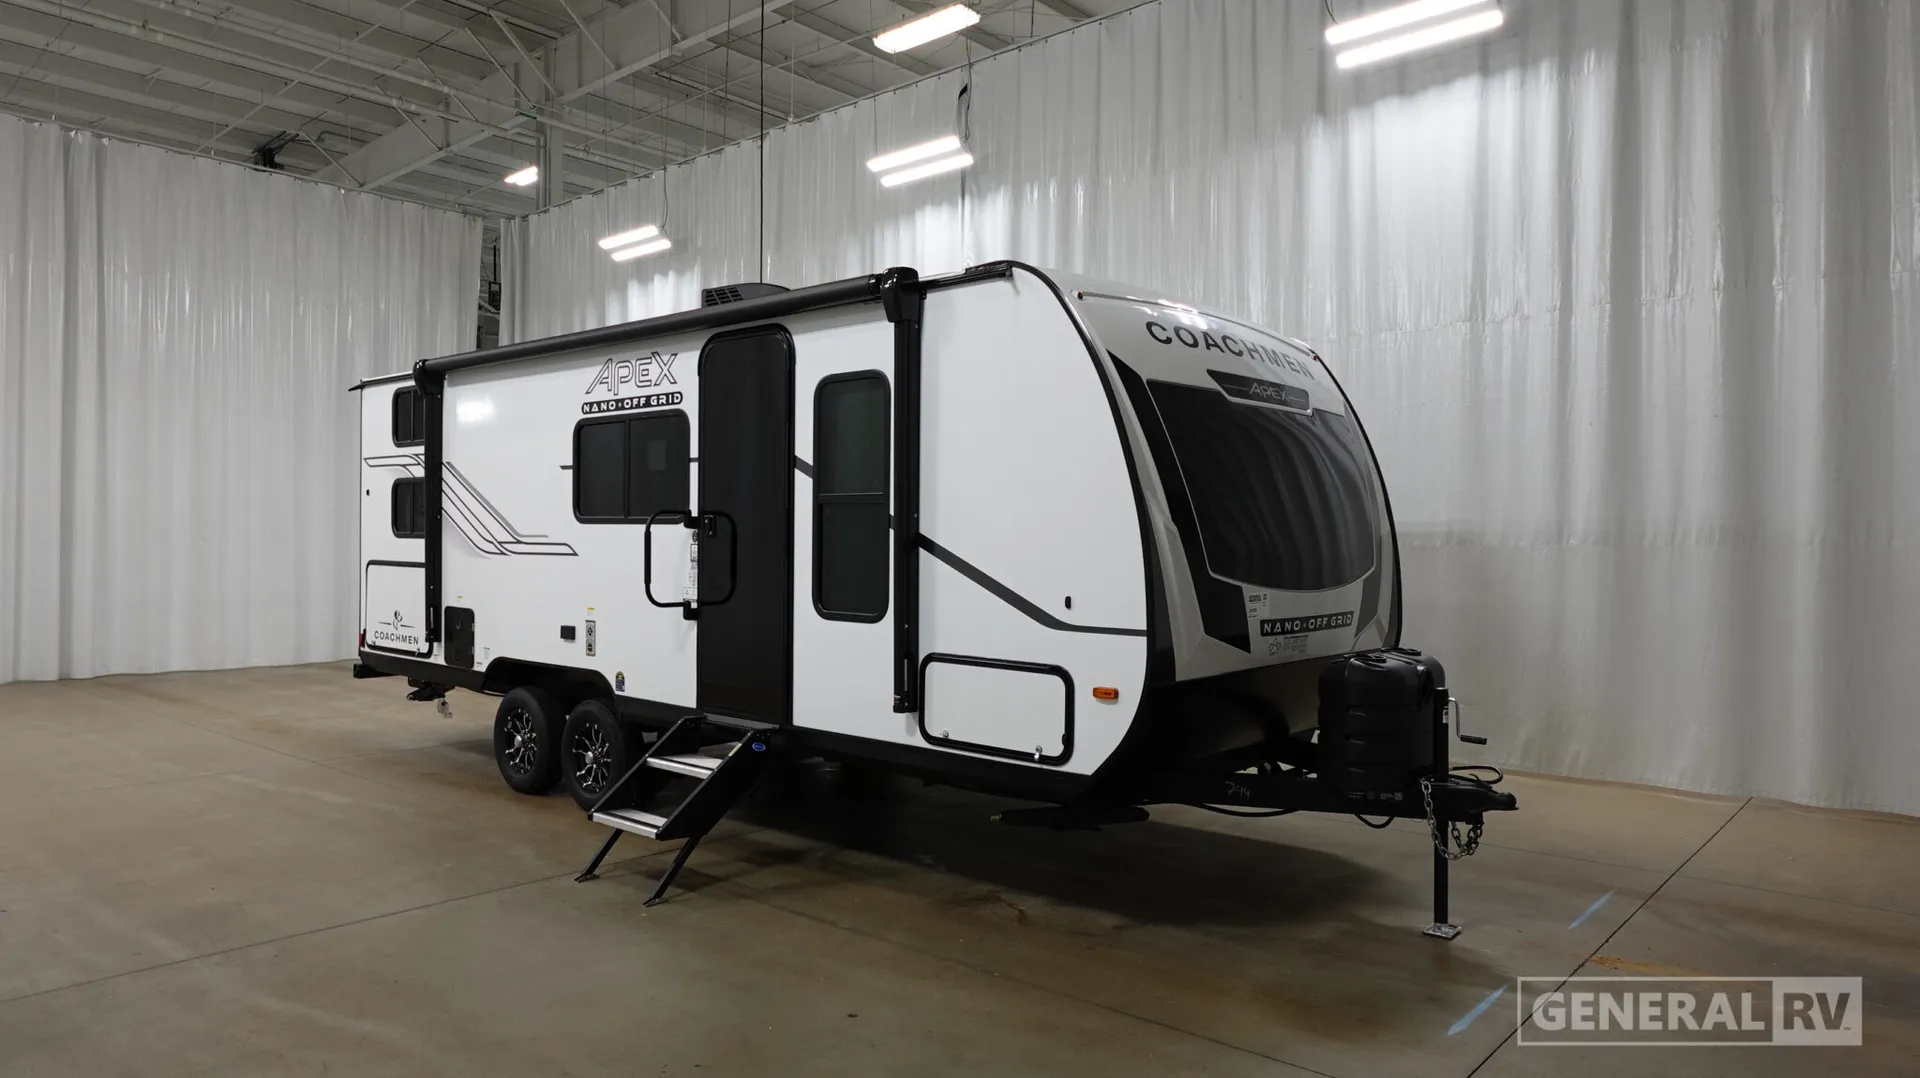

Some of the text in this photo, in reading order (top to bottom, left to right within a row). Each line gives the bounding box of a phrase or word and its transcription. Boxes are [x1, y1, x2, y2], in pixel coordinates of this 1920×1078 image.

[1146, 321, 1314, 380] COACHMEN
[585, 351, 678, 396] APEX
[1249, 382, 1289, 401] APEX
[583, 393, 682, 413] NANO OFF GRID
[1263, 614, 1353, 634] NANO OFF GRID
[374, 630, 419, 646] COACHMEN
